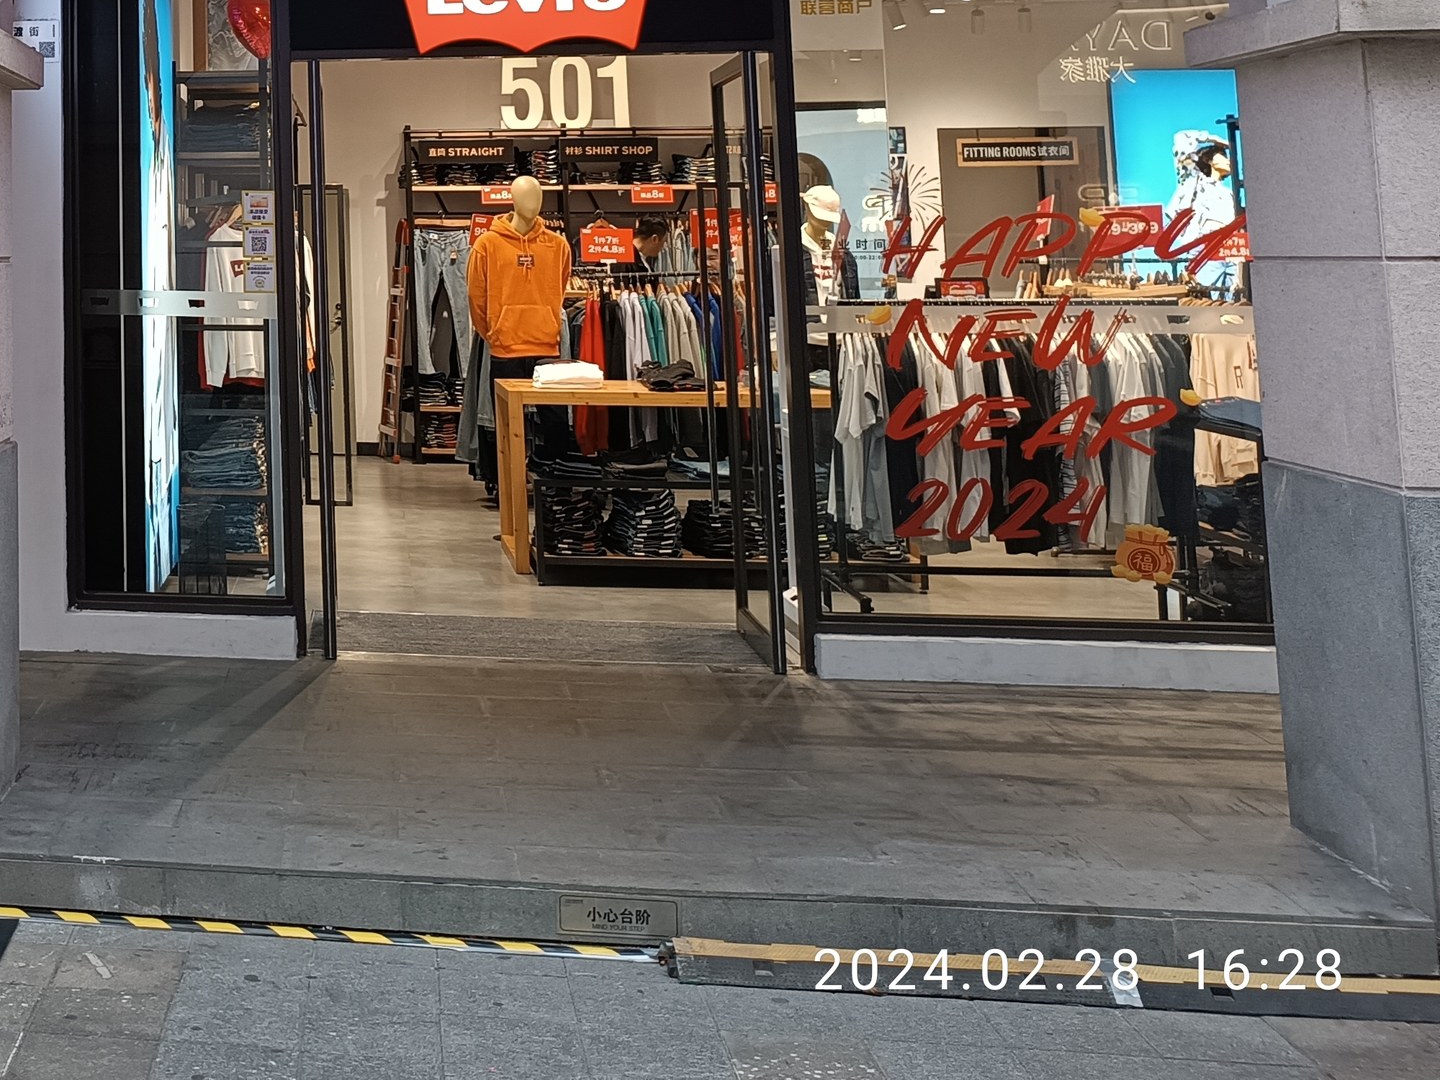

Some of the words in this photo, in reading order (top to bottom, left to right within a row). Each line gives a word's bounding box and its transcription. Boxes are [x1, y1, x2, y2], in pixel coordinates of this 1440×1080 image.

[500, 55, 632, 129] 501
[448, 147, 504, 157] STRAIGHT
[585, 146, 620, 155] SHIRT
[621, 146, 653, 155] SHOP
[963, 147, 1001, 159] FITTING
[1002, 146, 1037, 158] ROOMS
[1037, 145, 1070, 157] 试衣间
[881, 207, 1247, 279] HAPPY
[887, 294, 1128, 371] NEW
[885, 386, 1177, 461] YEAR
[894, 475, 1108, 542] 2024
[1132, 552, 1153, 572] 福
[587, 906, 651, 925] 小心台阶
[610, 924, 627, 932] YOUR
